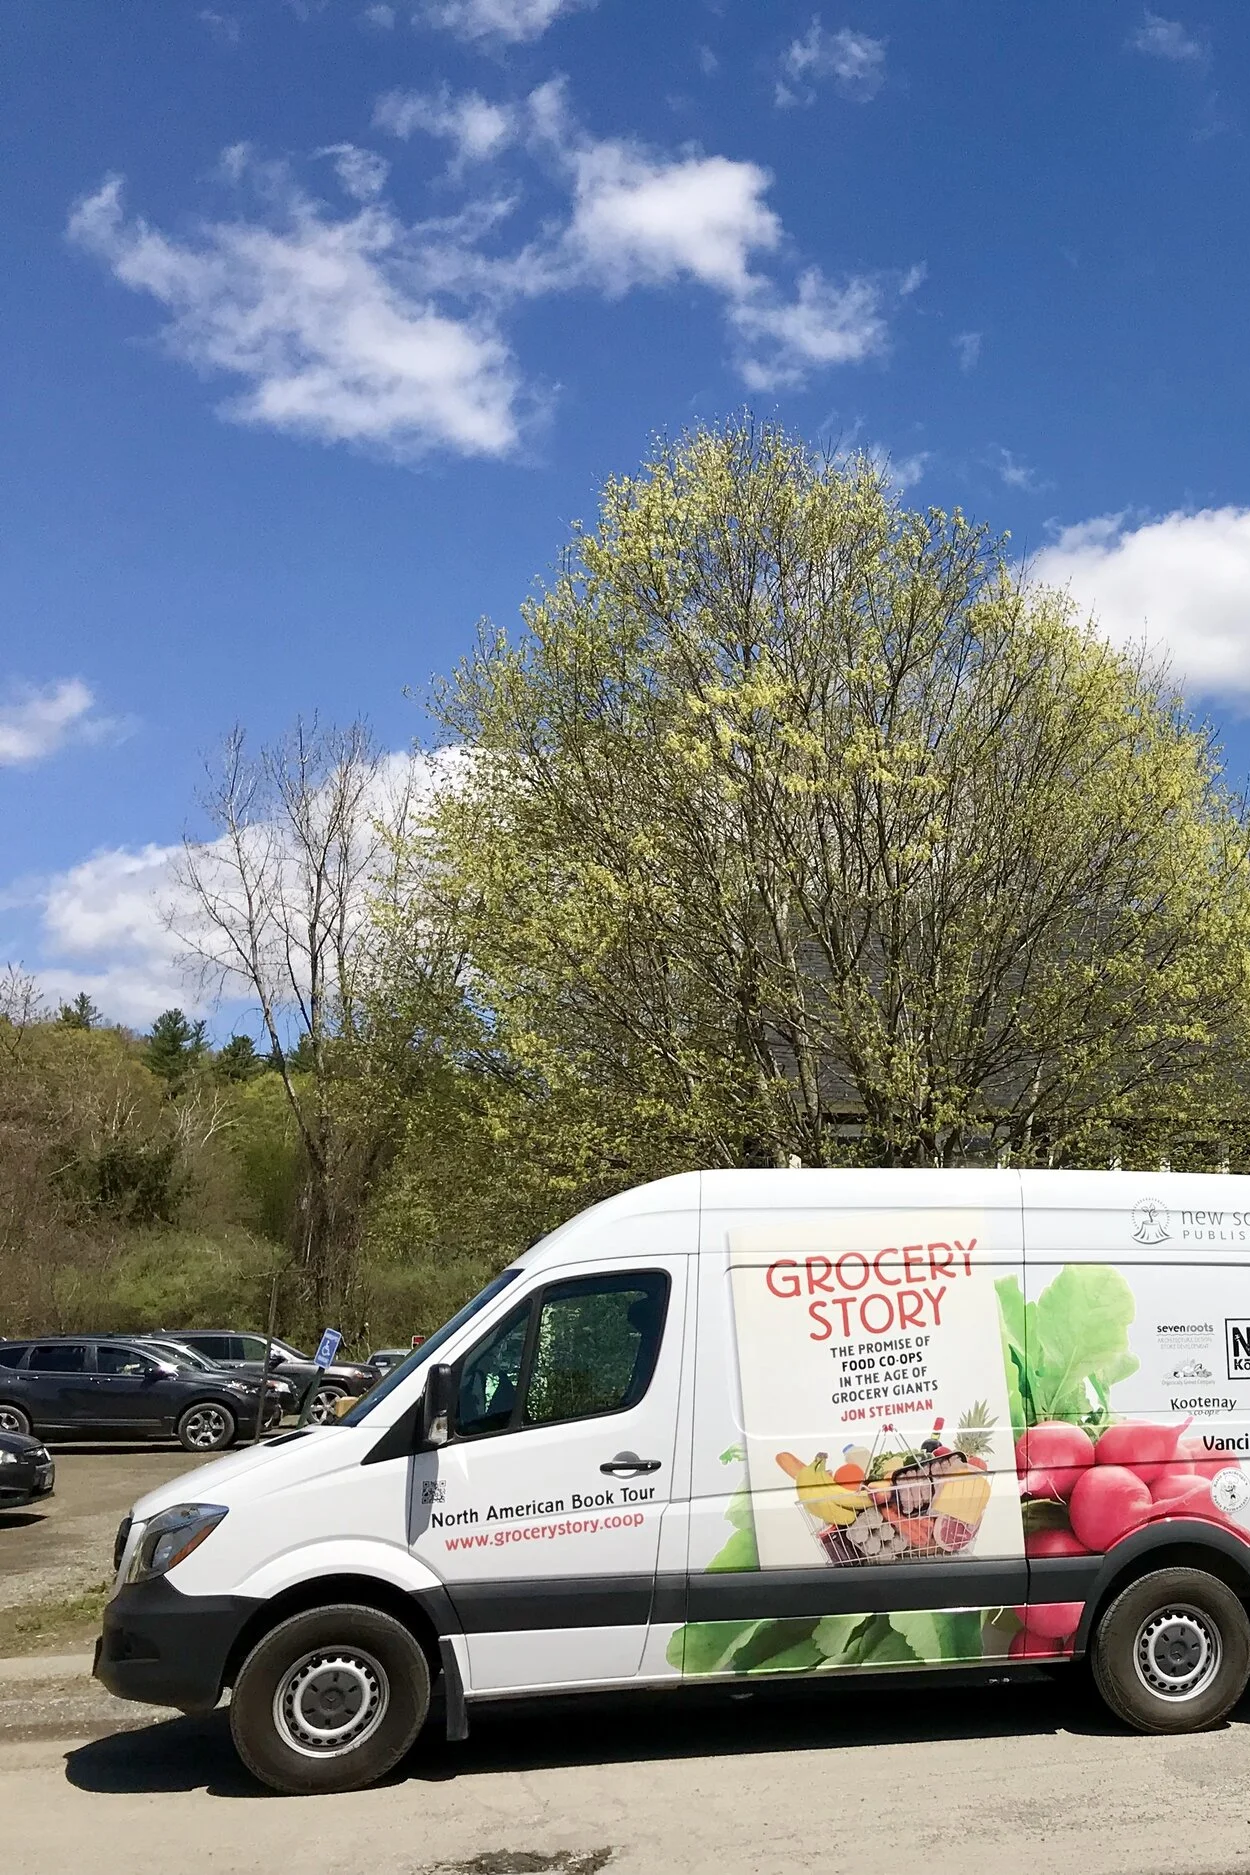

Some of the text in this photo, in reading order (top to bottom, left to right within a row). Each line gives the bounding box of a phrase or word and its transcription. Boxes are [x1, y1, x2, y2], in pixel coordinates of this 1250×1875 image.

[1181, 1208, 1224, 1226] new
[766, 1238, 978, 1298] GROCERY
[808, 1286, 947, 1341] STORY
[830, 1336, 930, 1358] THE PROMISE OF
[842, 1358, 875, 1372] FOOD
[840, 1366, 927, 1388] IN THE AGE OF
[832, 1380, 938, 1404] GROCERY GIANTS
[841, 1399, 933, 1422] JON STEINMAN
[1170, 1397, 1237, 1411] Kootenay
[431, 1486, 655, 1529] North American Book Tour
[445, 1511, 644, 1551] www.grocerystory.coop
